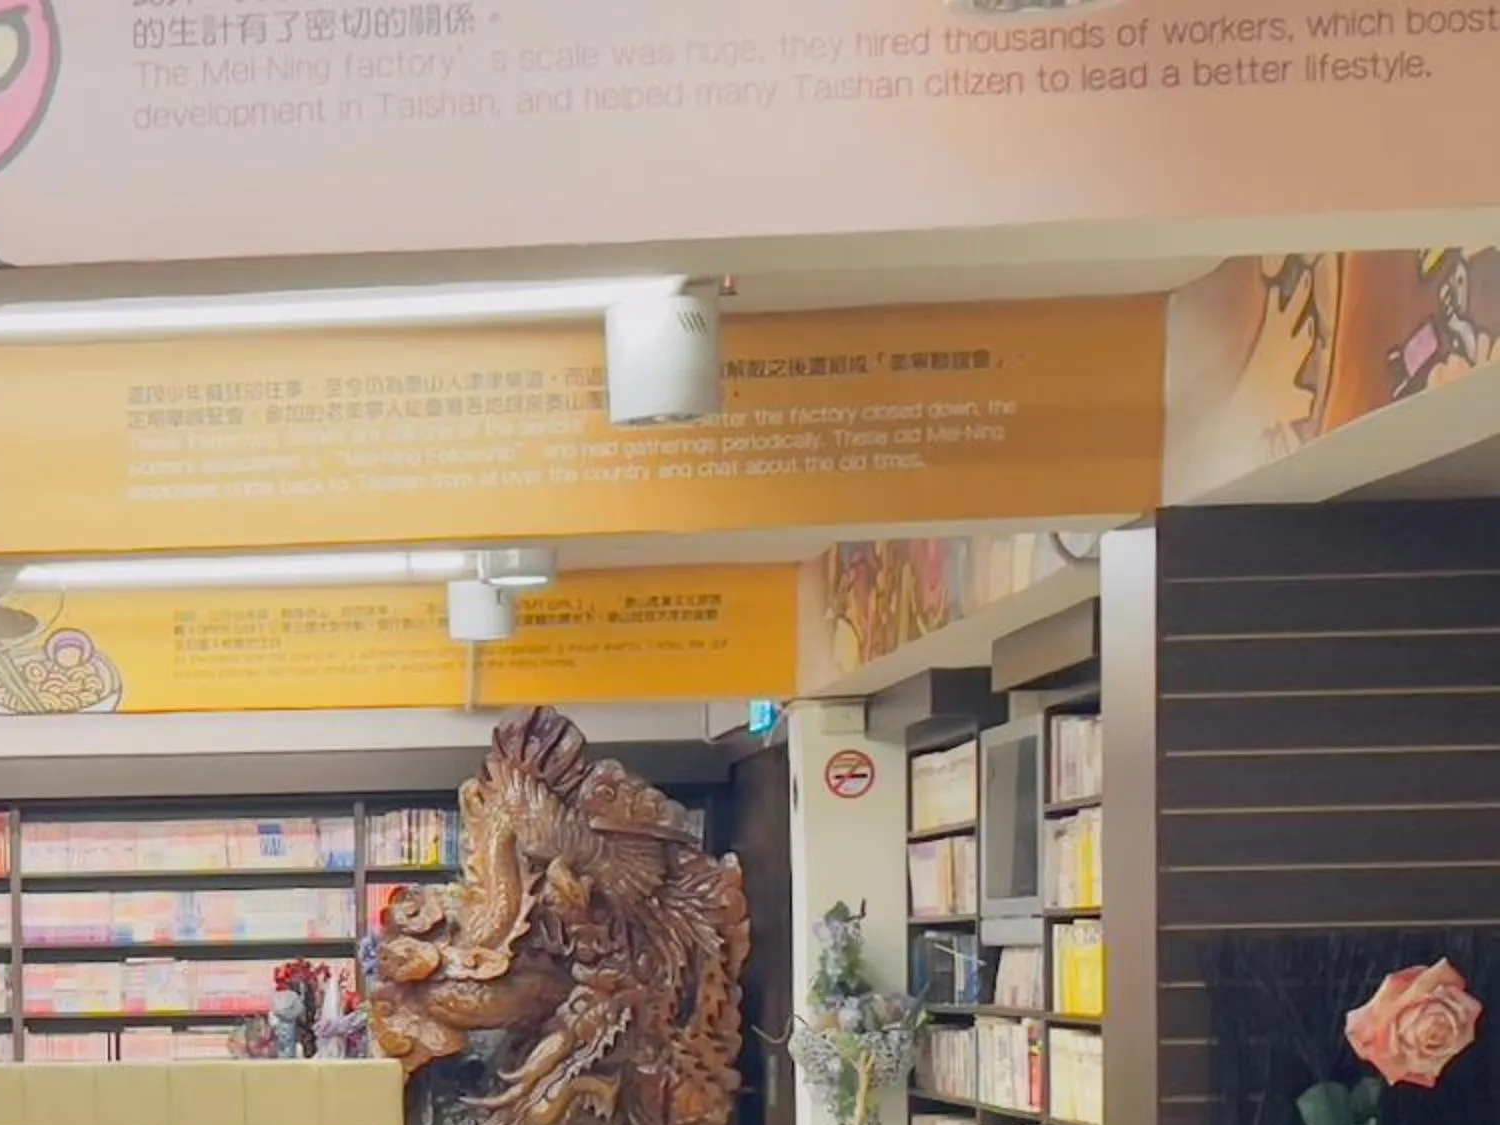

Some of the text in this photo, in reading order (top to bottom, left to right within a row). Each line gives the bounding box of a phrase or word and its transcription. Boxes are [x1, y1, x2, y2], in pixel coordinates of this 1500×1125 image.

[134, 60, 191, 89] The
[518, 42, 600, 72] scale
[610, 43, 676, 68] was
[685, 36, 767, 67] huge,
[777, 30, 844, 64] they
[854, 25, 931, 57] hired
[942, 20, 1105, 55] thousands
[1116, 18, 1150, 48] of
[1163, 13, 1295, 46] workers,
[1305, 8, 1394, 38] which
[132, 48, 1433, 131] development in Taishan, and helped many Taishan citizen to lead a better lifestyle.
[754, 408, 784, 425] the
[790, 405, 857, 426] factory
